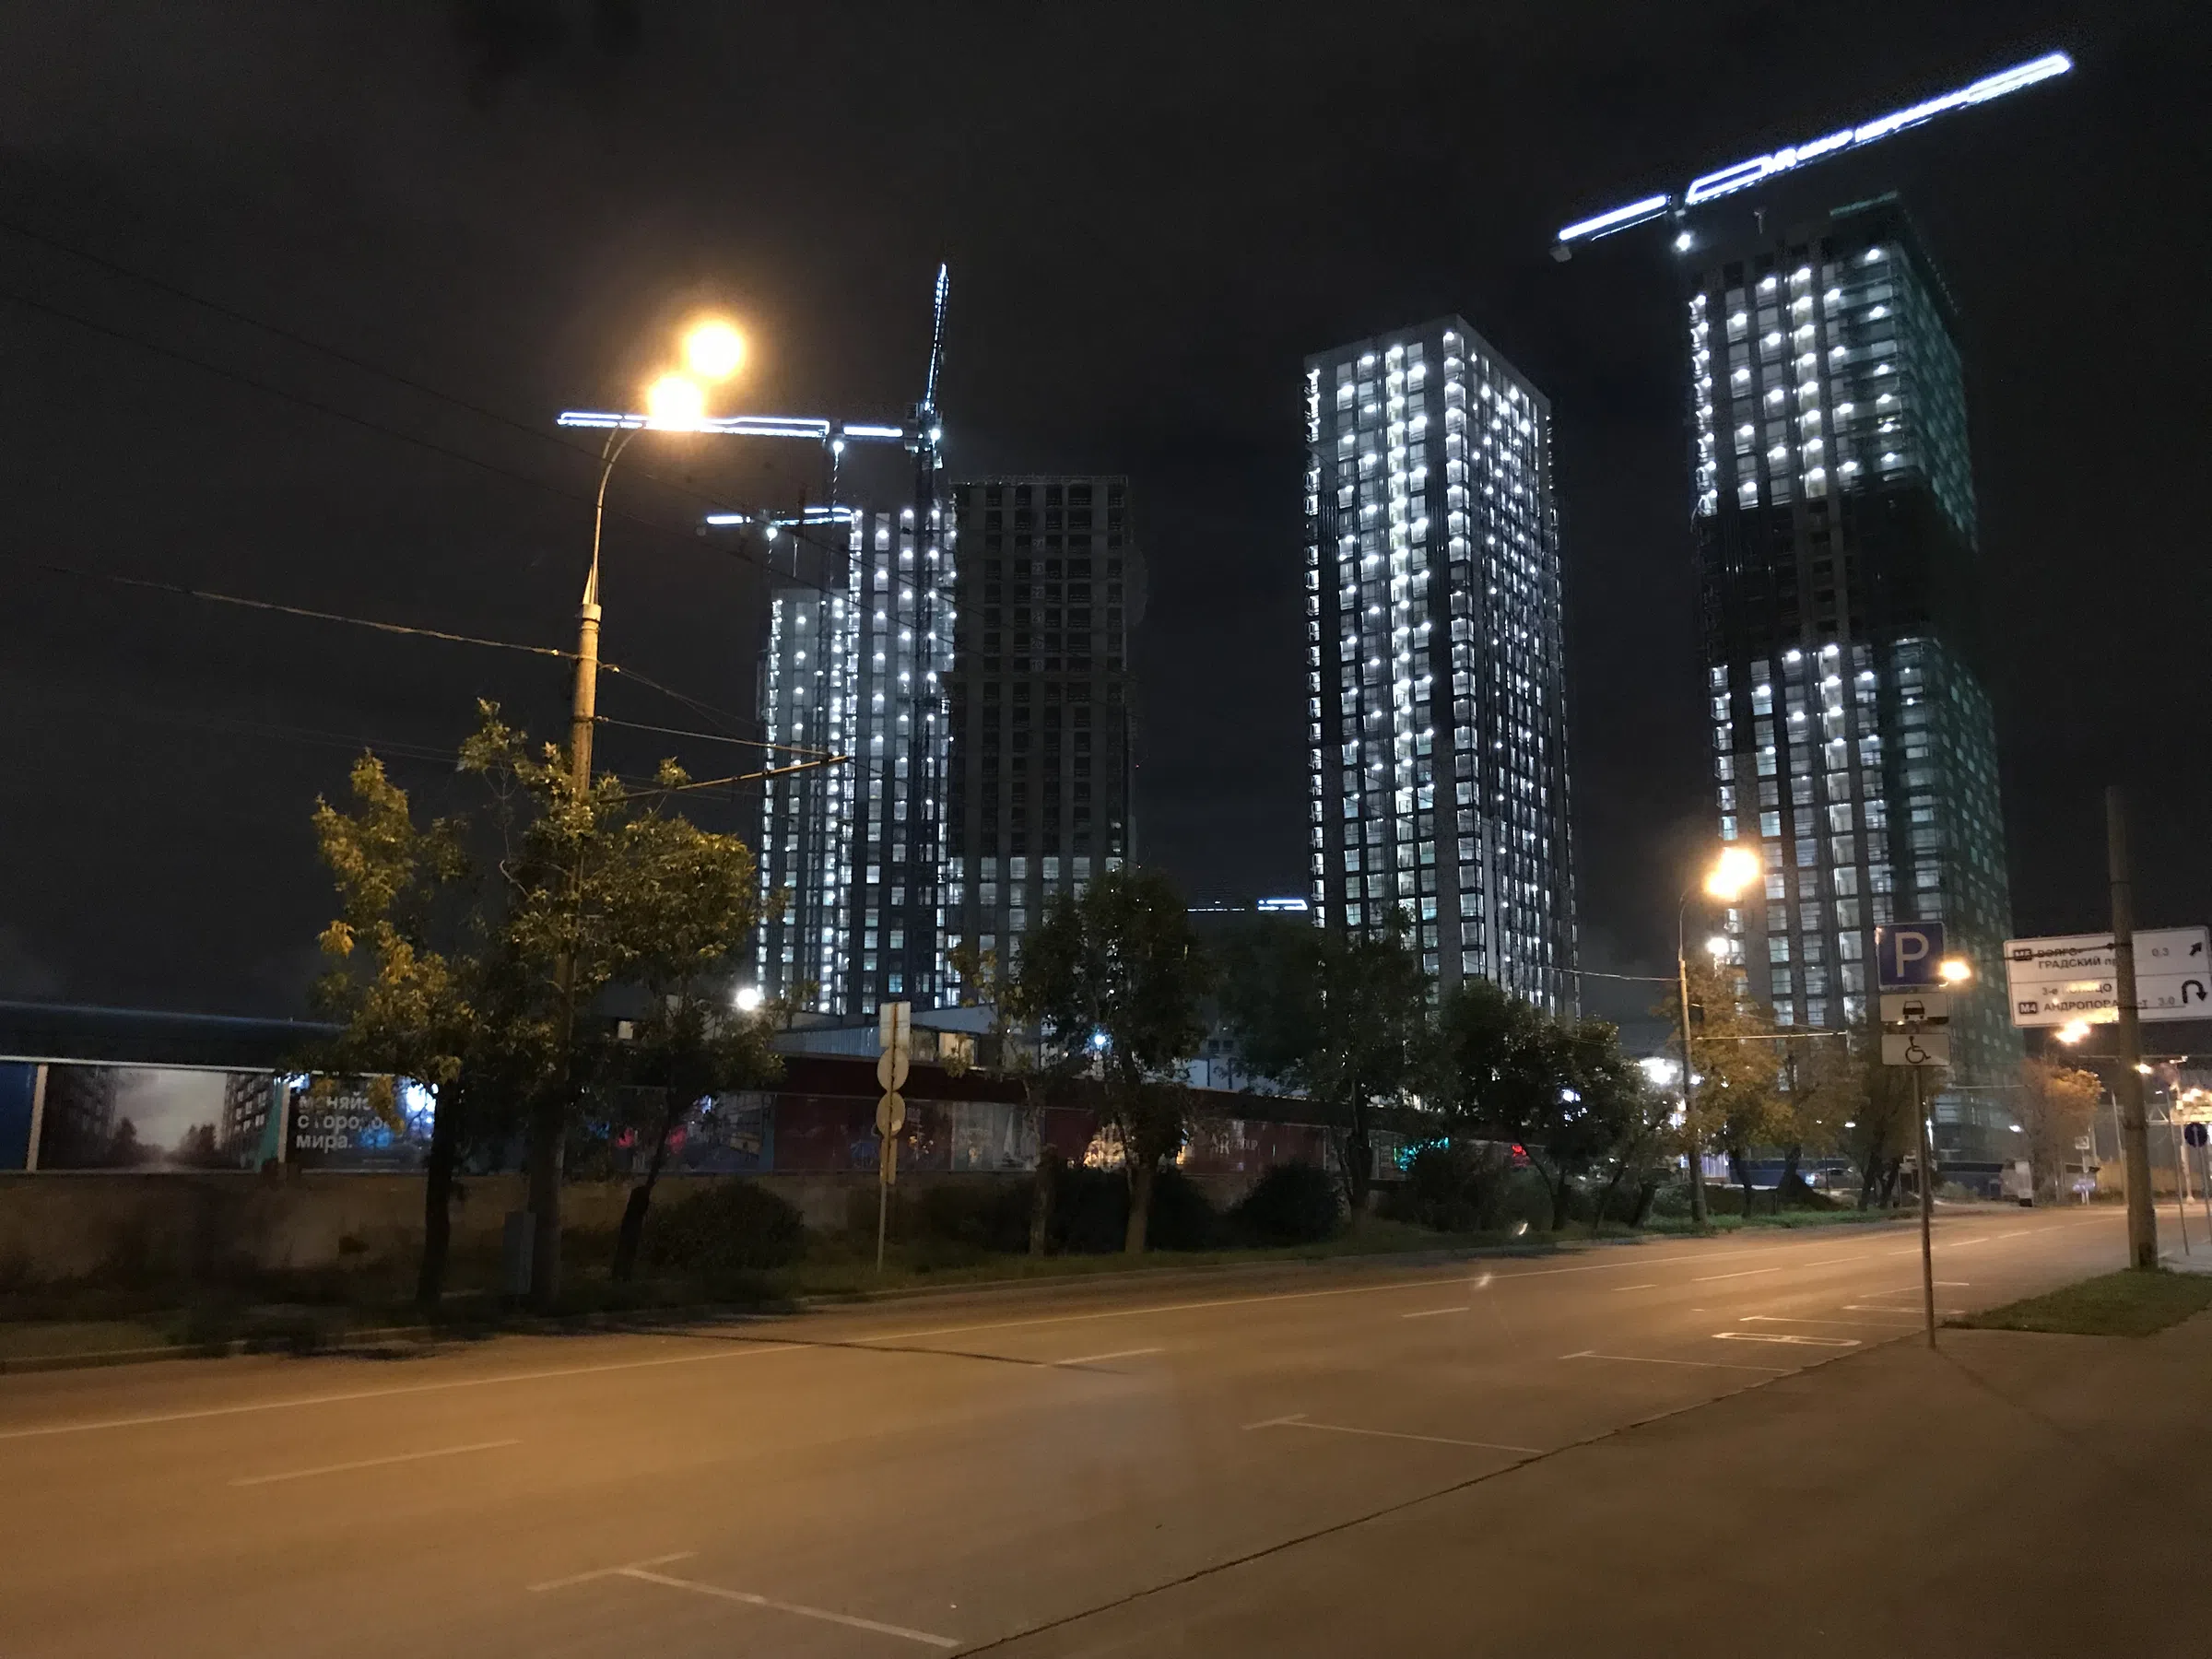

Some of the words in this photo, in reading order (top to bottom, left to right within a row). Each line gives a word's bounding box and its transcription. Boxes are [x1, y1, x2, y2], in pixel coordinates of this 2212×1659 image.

[1895, 931, 1930, 978] P
[2039, 957, 2101, 970] ГРАДСКИЙ
[2020, 1003, 2037, 1013] М4
[296, 1135, 353, 1153] мира.
